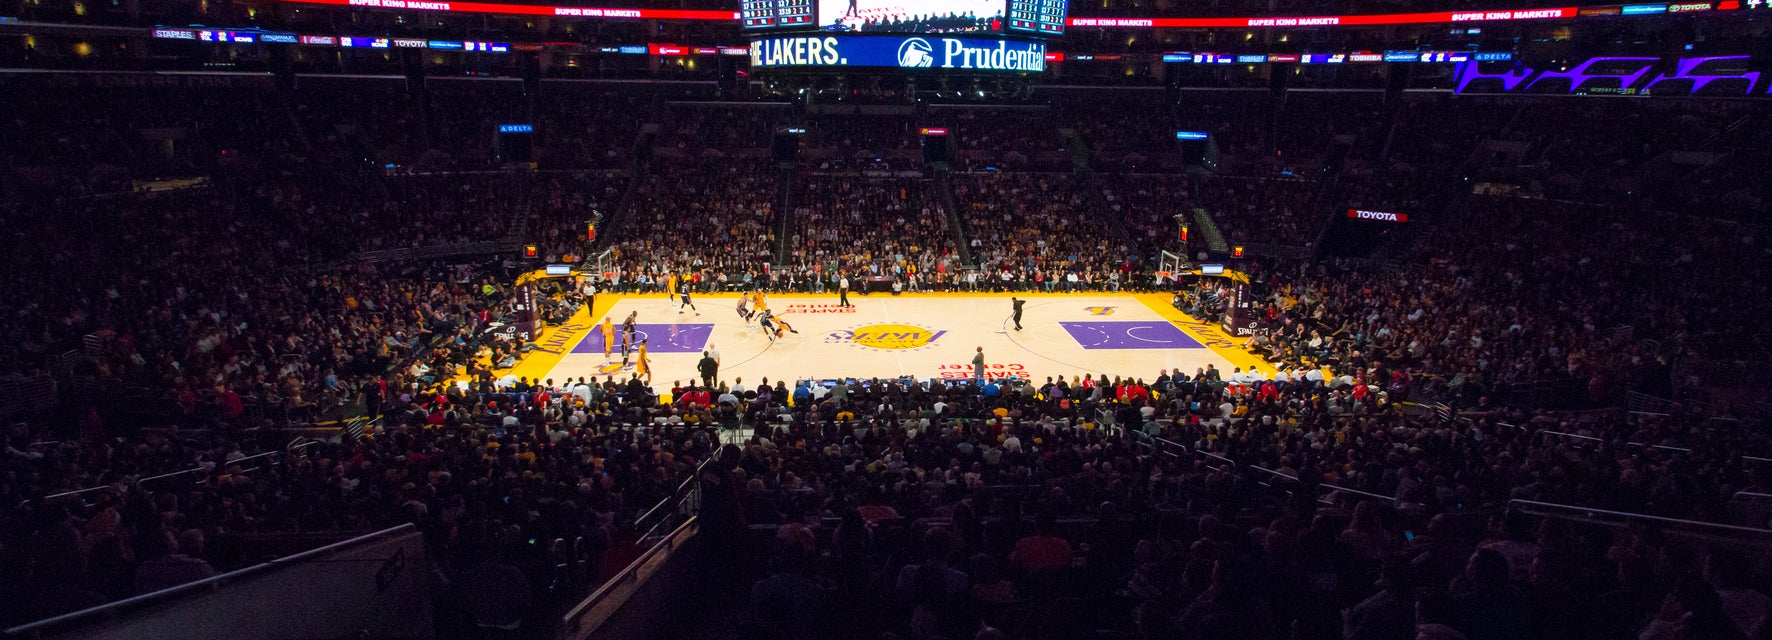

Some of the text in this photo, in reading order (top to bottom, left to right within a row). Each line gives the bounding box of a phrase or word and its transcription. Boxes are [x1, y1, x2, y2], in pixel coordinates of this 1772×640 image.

[382, 0, 405, 8] KING
[408, 1, 450, 10] MARKETS
[555, 8, 581, 16] SUPER
[583, 9, 602, 17] KING
[1452, 10, 1562, 21] SUPER KING MARKETS
[1299, 18, 1339, 26] MARKETS
[156, 29, 193, 38] STAPLES
[394, 40, 427, 48] TOYOTA
[766, 36, 848, 66] LAKERS.
[941, 38, 1045, 72] Prudential
[1356, 210, 1397, 221] TOYOTA
